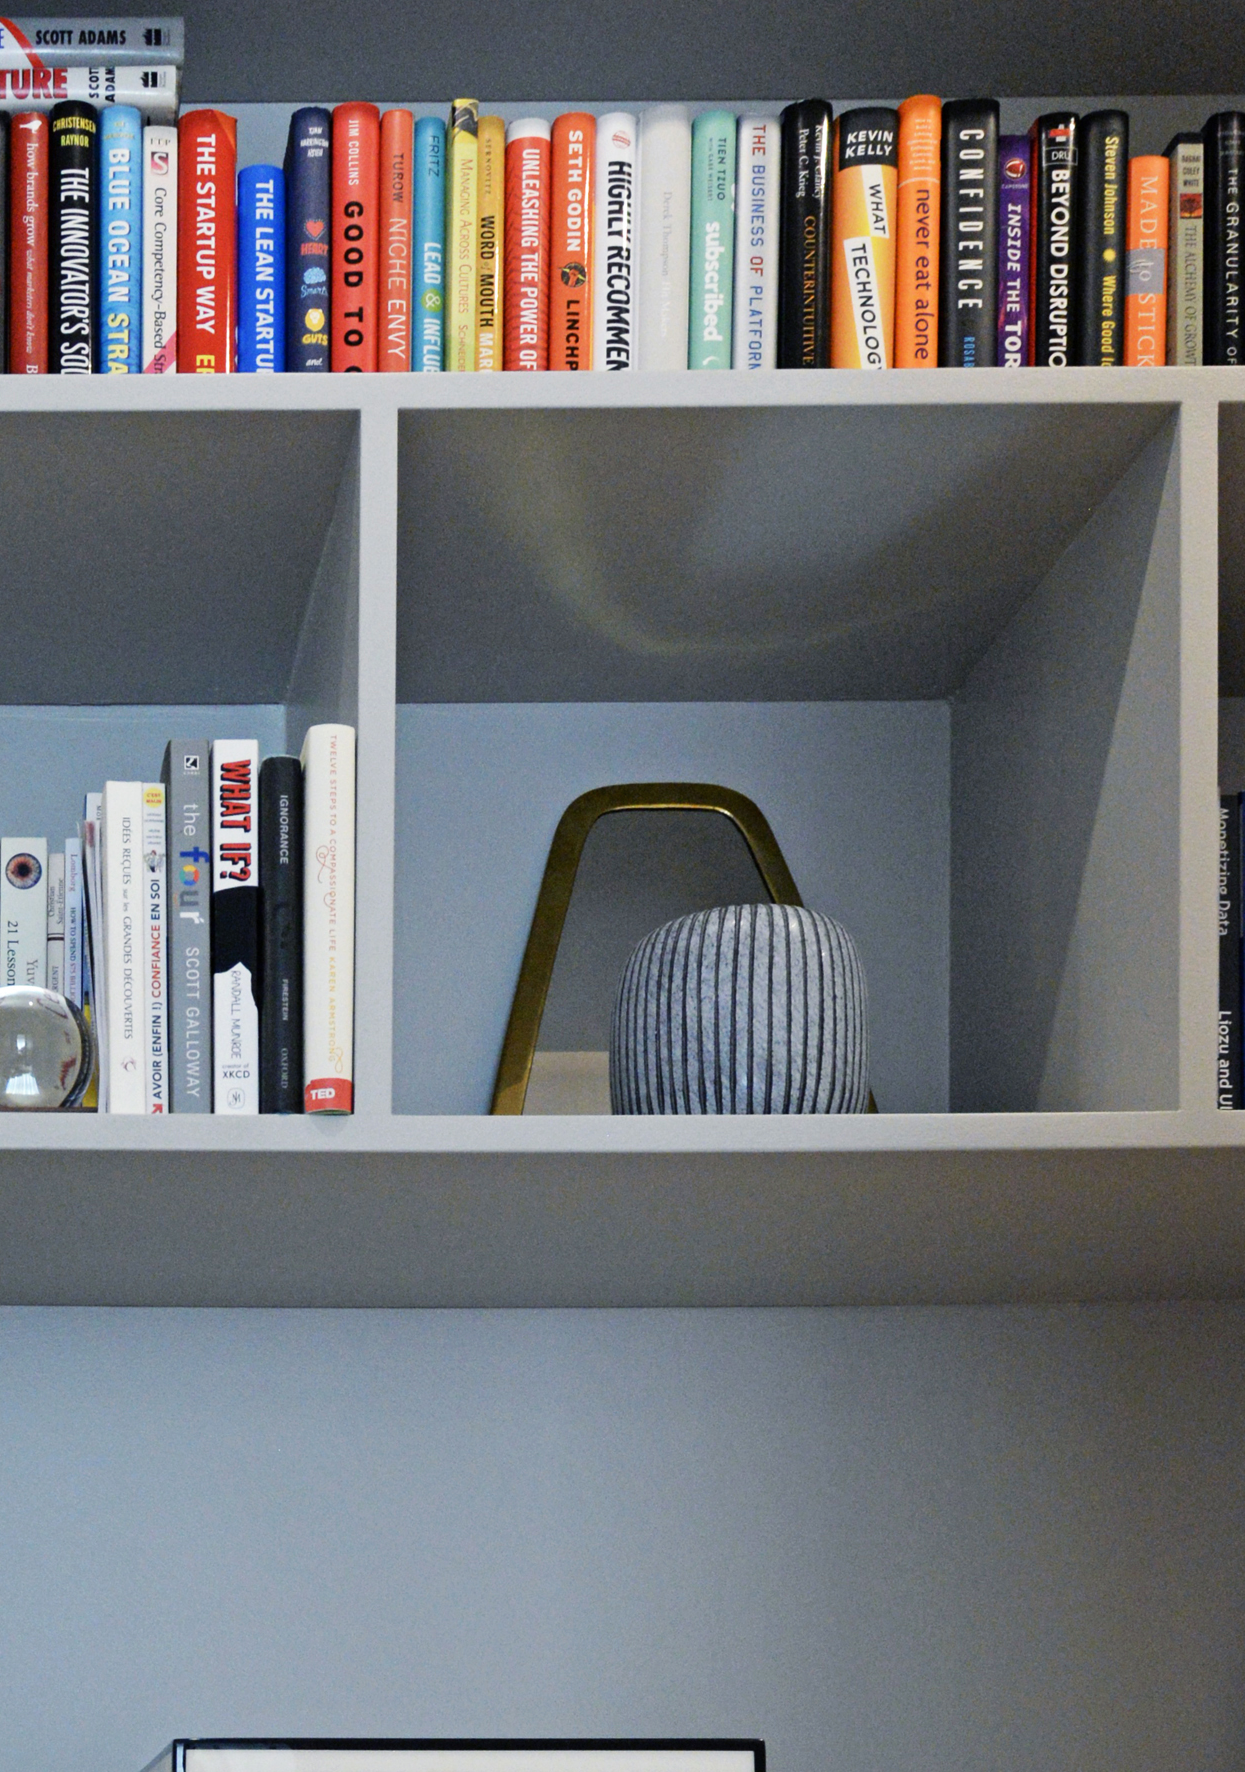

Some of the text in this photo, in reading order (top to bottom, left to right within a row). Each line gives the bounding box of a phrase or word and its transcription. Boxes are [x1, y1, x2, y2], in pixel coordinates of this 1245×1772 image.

[35, 30, 127, 46] SCOTT ADAMS
[61, 135, 89, 147] RAYNOR
[428, 135, 440, 177] FRITZ
[567, 130, 583, 252] SETH GODIN
[846, 144, 892, 158] KELLY
[847, 130, 894, 145] KEVIN
[23, 143, 38, 247] how brands grow
[60, 168, 90, 335] THE INNOVATOR'S
[107, 149, 130, 302] BLUE OCEAN
[196, 134, 215, 334] THE STARTUP WAY
[256, 180, 273, 281] THE LEAN
[344, 120, 364, 347] JIM COLLINS GOOD TO
[750, 125, 766, 277] THE BUSINESS OF
[869, 184, 885, 235] WHAT
[916, 190, 933, 252] never
[957, 129, 985, 309] CONFIDENCE
[1051, 170, 1069, 257] BEYOND
[1101, 137, 1119, 354] Steven Johnson Where Good
[152, 188, 167, 349] Core Competency-Based
[388, 153, 407, 359] TUROW NICHE ENVY
[423, 242, 441, 284] LEAD
[519, 149, 540, 370] UNLEASHING THE POWER OF
[703, 222, 725, 341] subscribed
[802, 216, 816, 365] COUNTERINTUITIVE
[916, 256, 932, 290] eat
[1006, 204, 1022, 312] INSIDE THE
[1225, 169, 1239, 365] THE GRANULARITY OF
[915, 300, 934, 359] alone
[220, 759, 252, 882] WHAT IF?
[279, 794, 289, 864] IGNORANCE
[120, 817, 135, 1039] IDÉES REÇUES GRANDES DÉCOUVERTES
[179, 804, 209, 1098] the four SCOTT GALLOWAY
[222, 1070, 250, 1079] XKCD
[310, 1088, 335, 1099] TED
